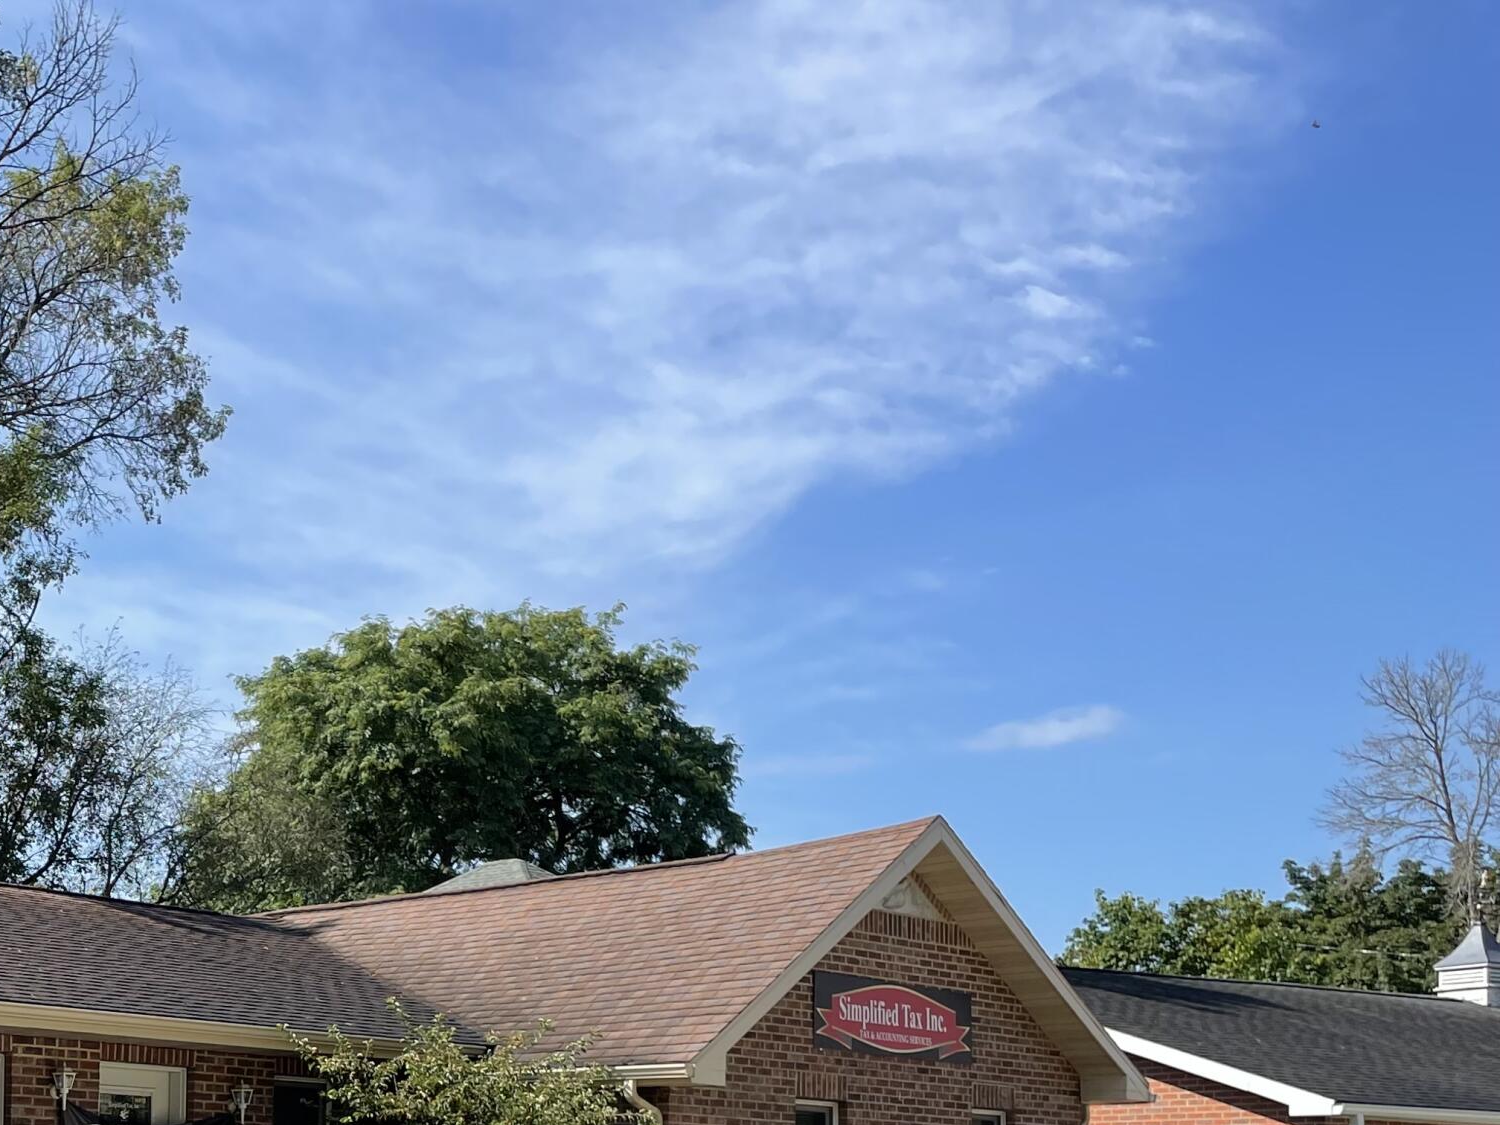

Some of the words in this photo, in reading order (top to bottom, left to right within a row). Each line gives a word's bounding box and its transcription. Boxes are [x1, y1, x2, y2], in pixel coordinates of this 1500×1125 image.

[839, 996, 899, 1030] Simplified
[902, 1004, 923, 1029] Tax
[926, 1008, 947, 1032] Inc.
